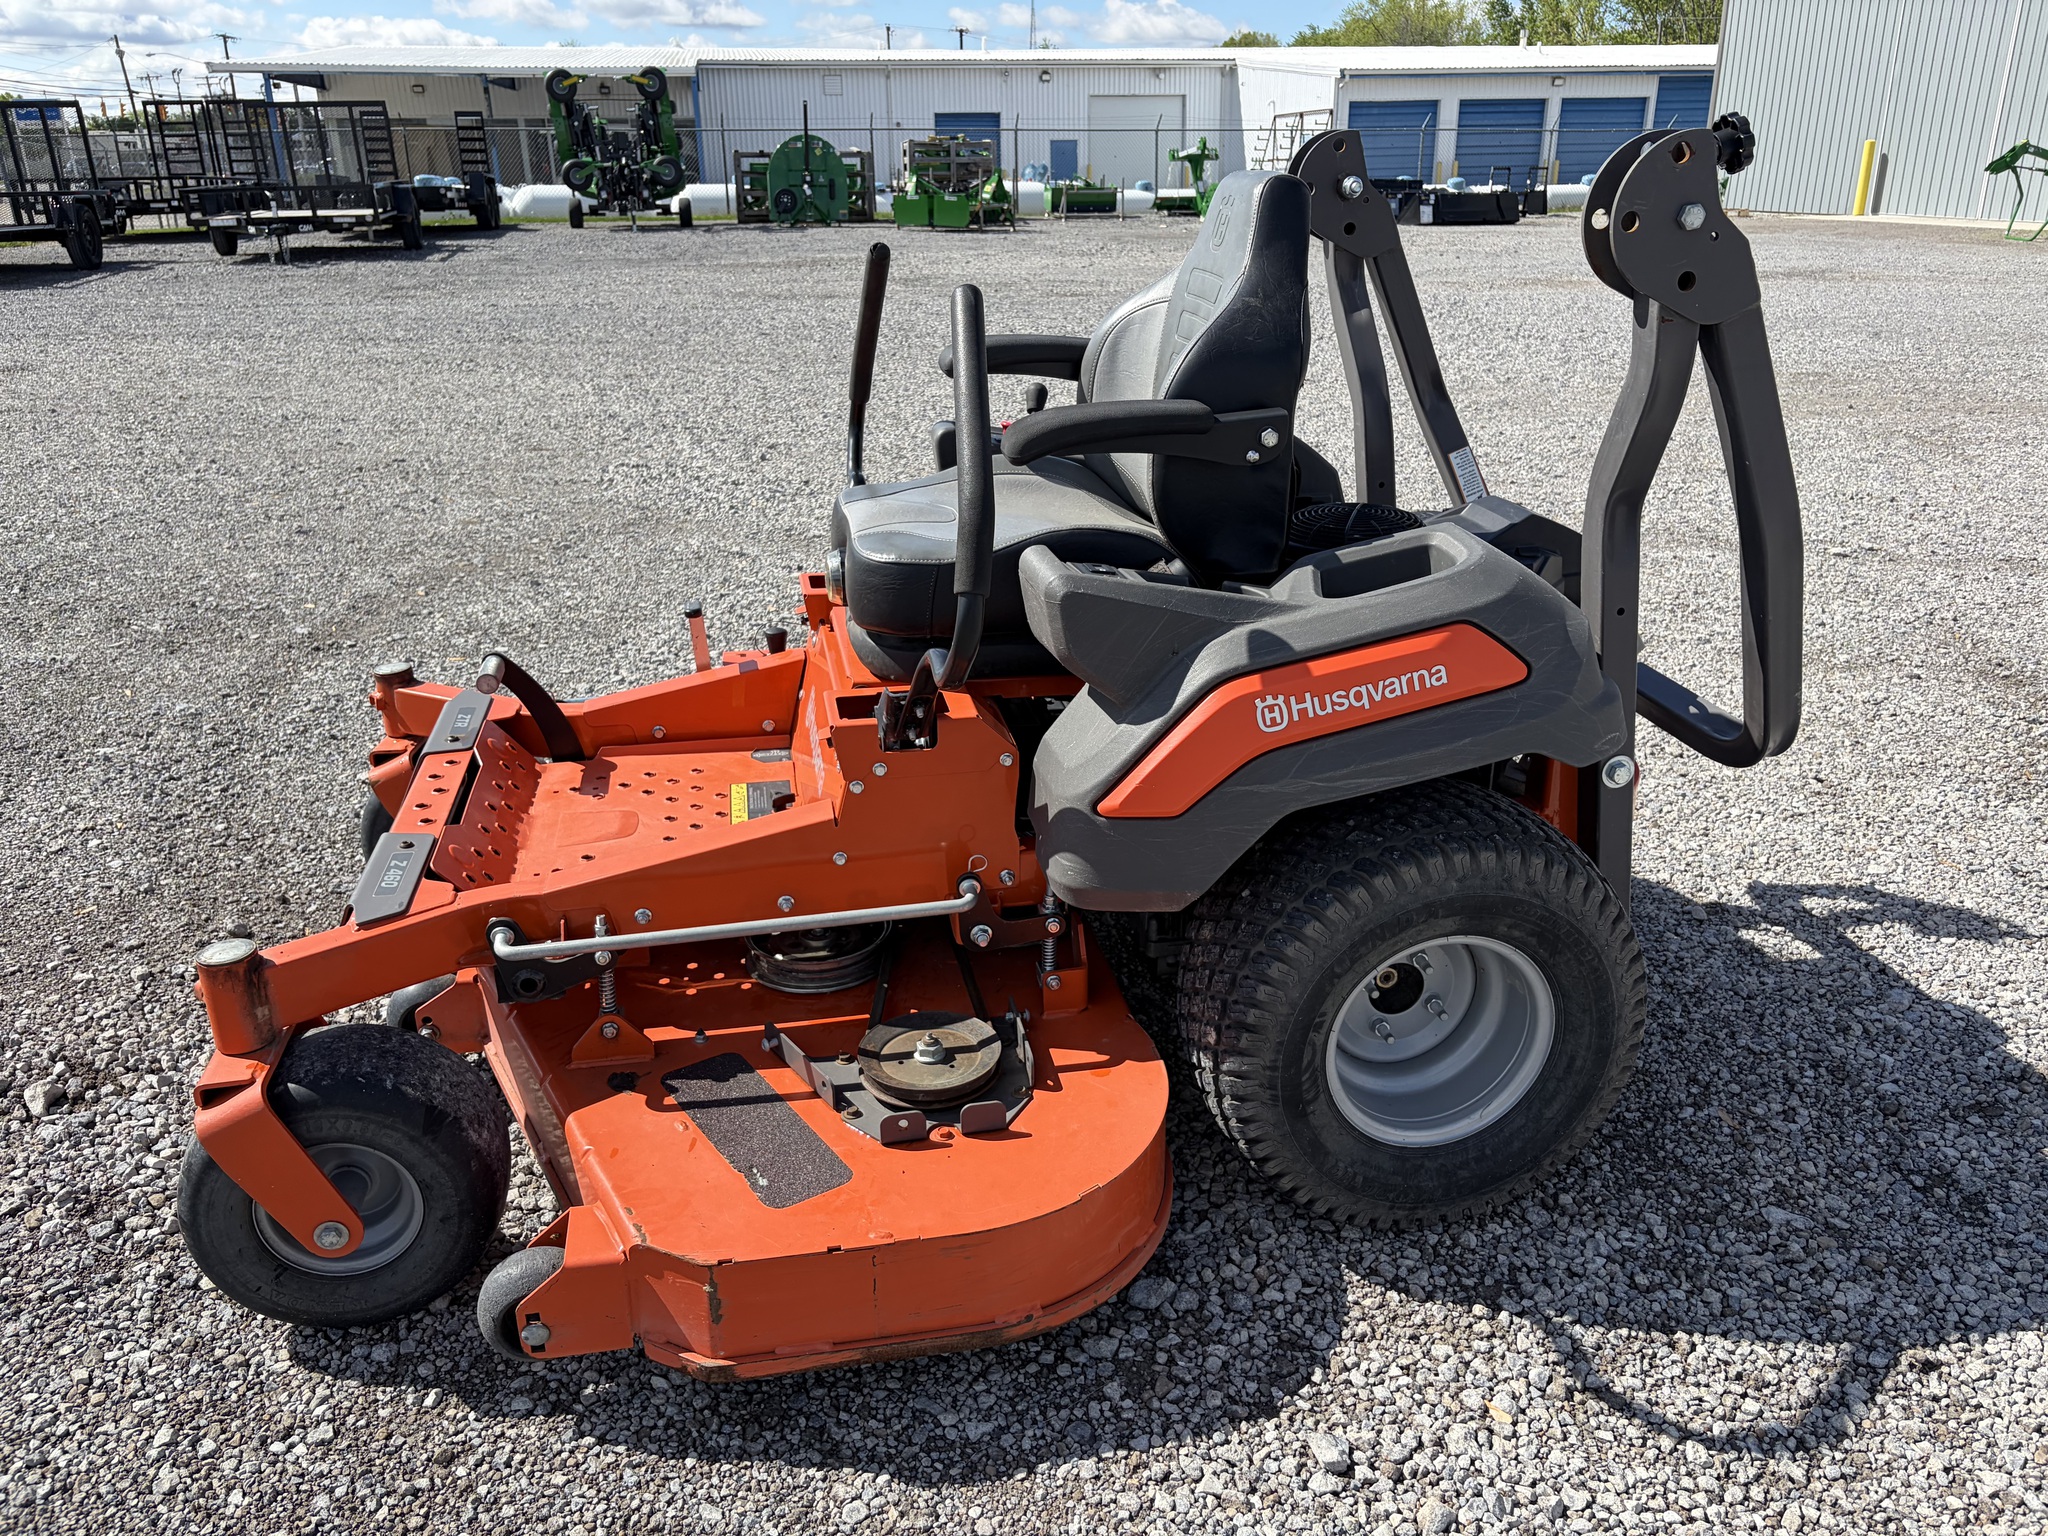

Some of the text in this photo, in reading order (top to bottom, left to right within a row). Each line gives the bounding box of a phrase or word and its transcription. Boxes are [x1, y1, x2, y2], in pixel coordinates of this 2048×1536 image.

[1289, 664, 1448, 721] Husqvarna
[454, 714, 471, 728] ZTR
[380, 859, 408, 889] Z 460
